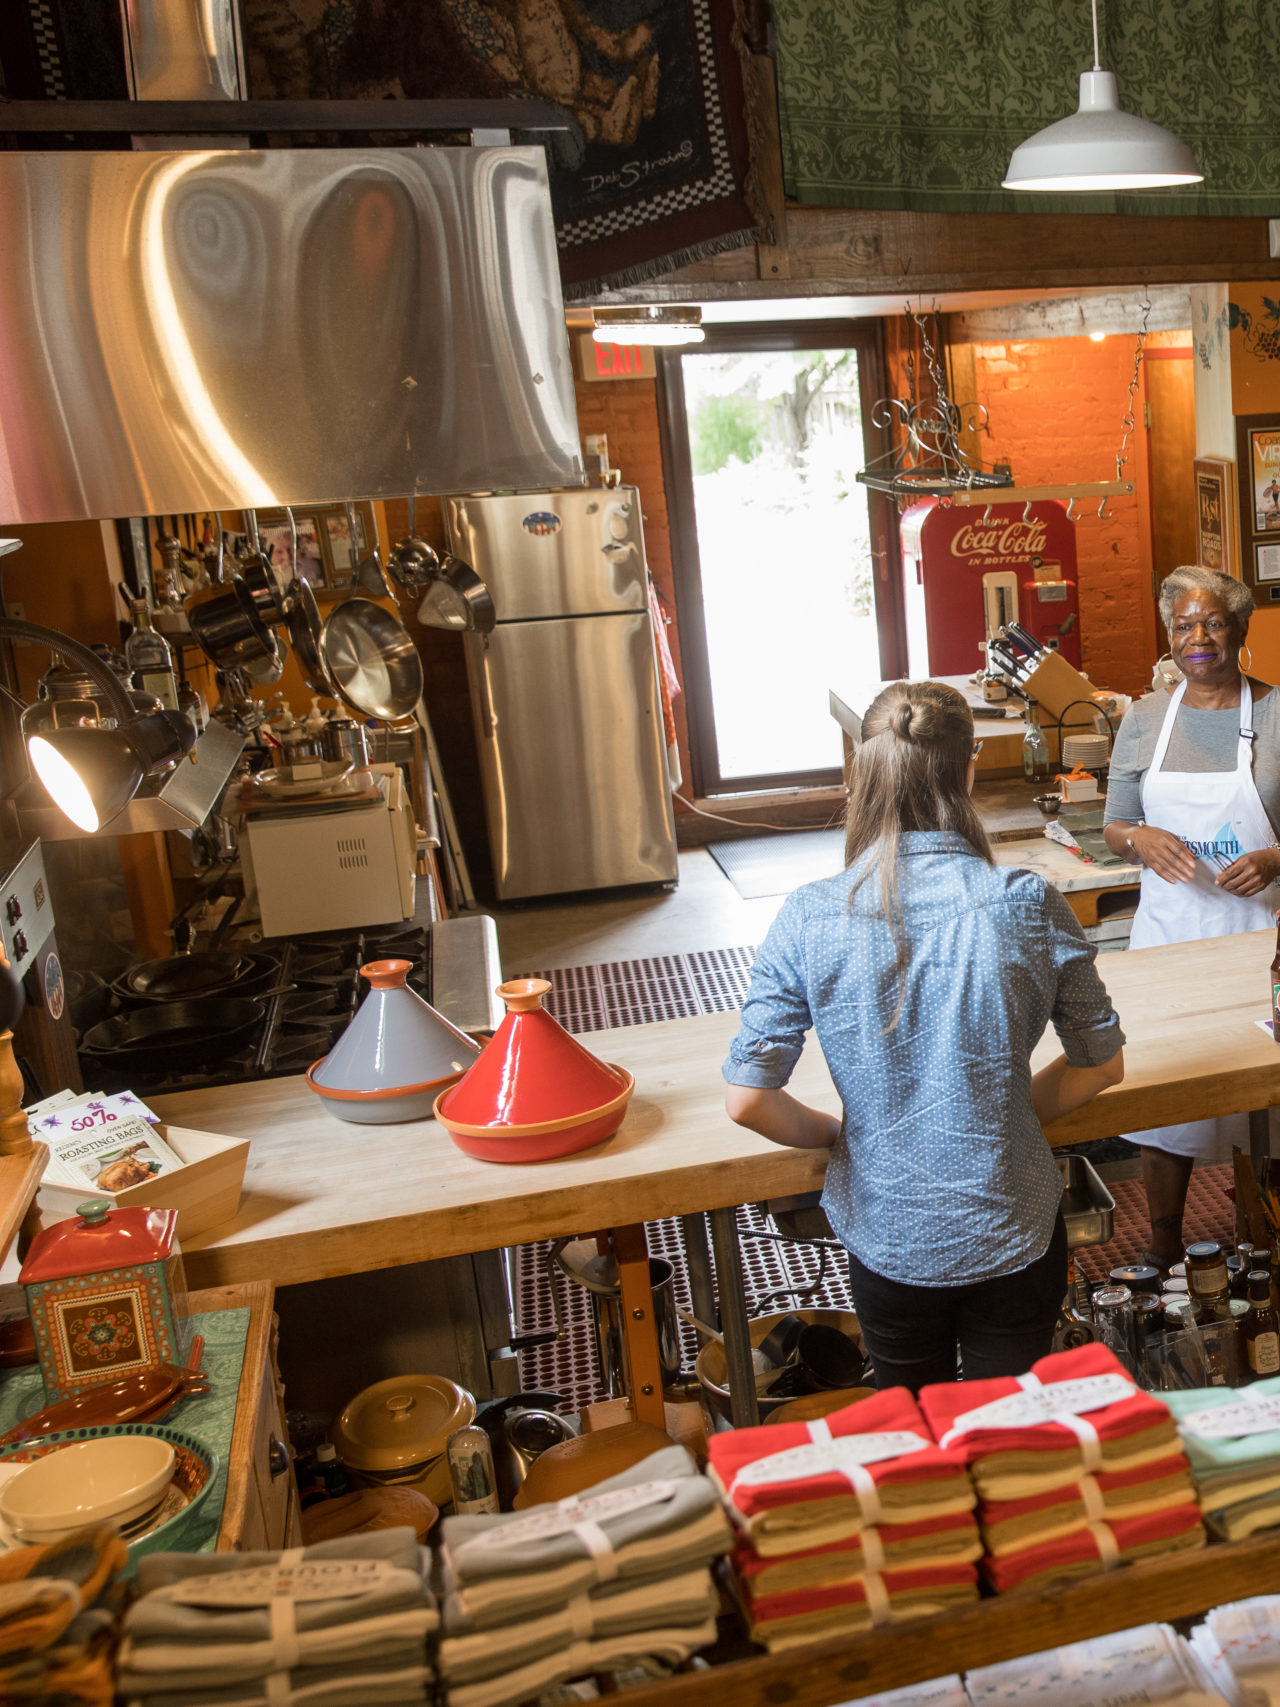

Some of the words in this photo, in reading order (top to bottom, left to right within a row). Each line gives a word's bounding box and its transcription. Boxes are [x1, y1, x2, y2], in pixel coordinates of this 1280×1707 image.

[594, 341, 643, 376] EXIT
[951, 521, 1048, 557] Coca-Cola
[968, 557, 982, 566] IN
[984, 555, 1031, 565] BOTTLES
[1184, 840, 1239, 856] TSMOUTH
[71, 1109, 118, 1132] 50%
[59, 1135, 116, 1162] ROASTING
[117, 1126, 144, 1140] BAGS
